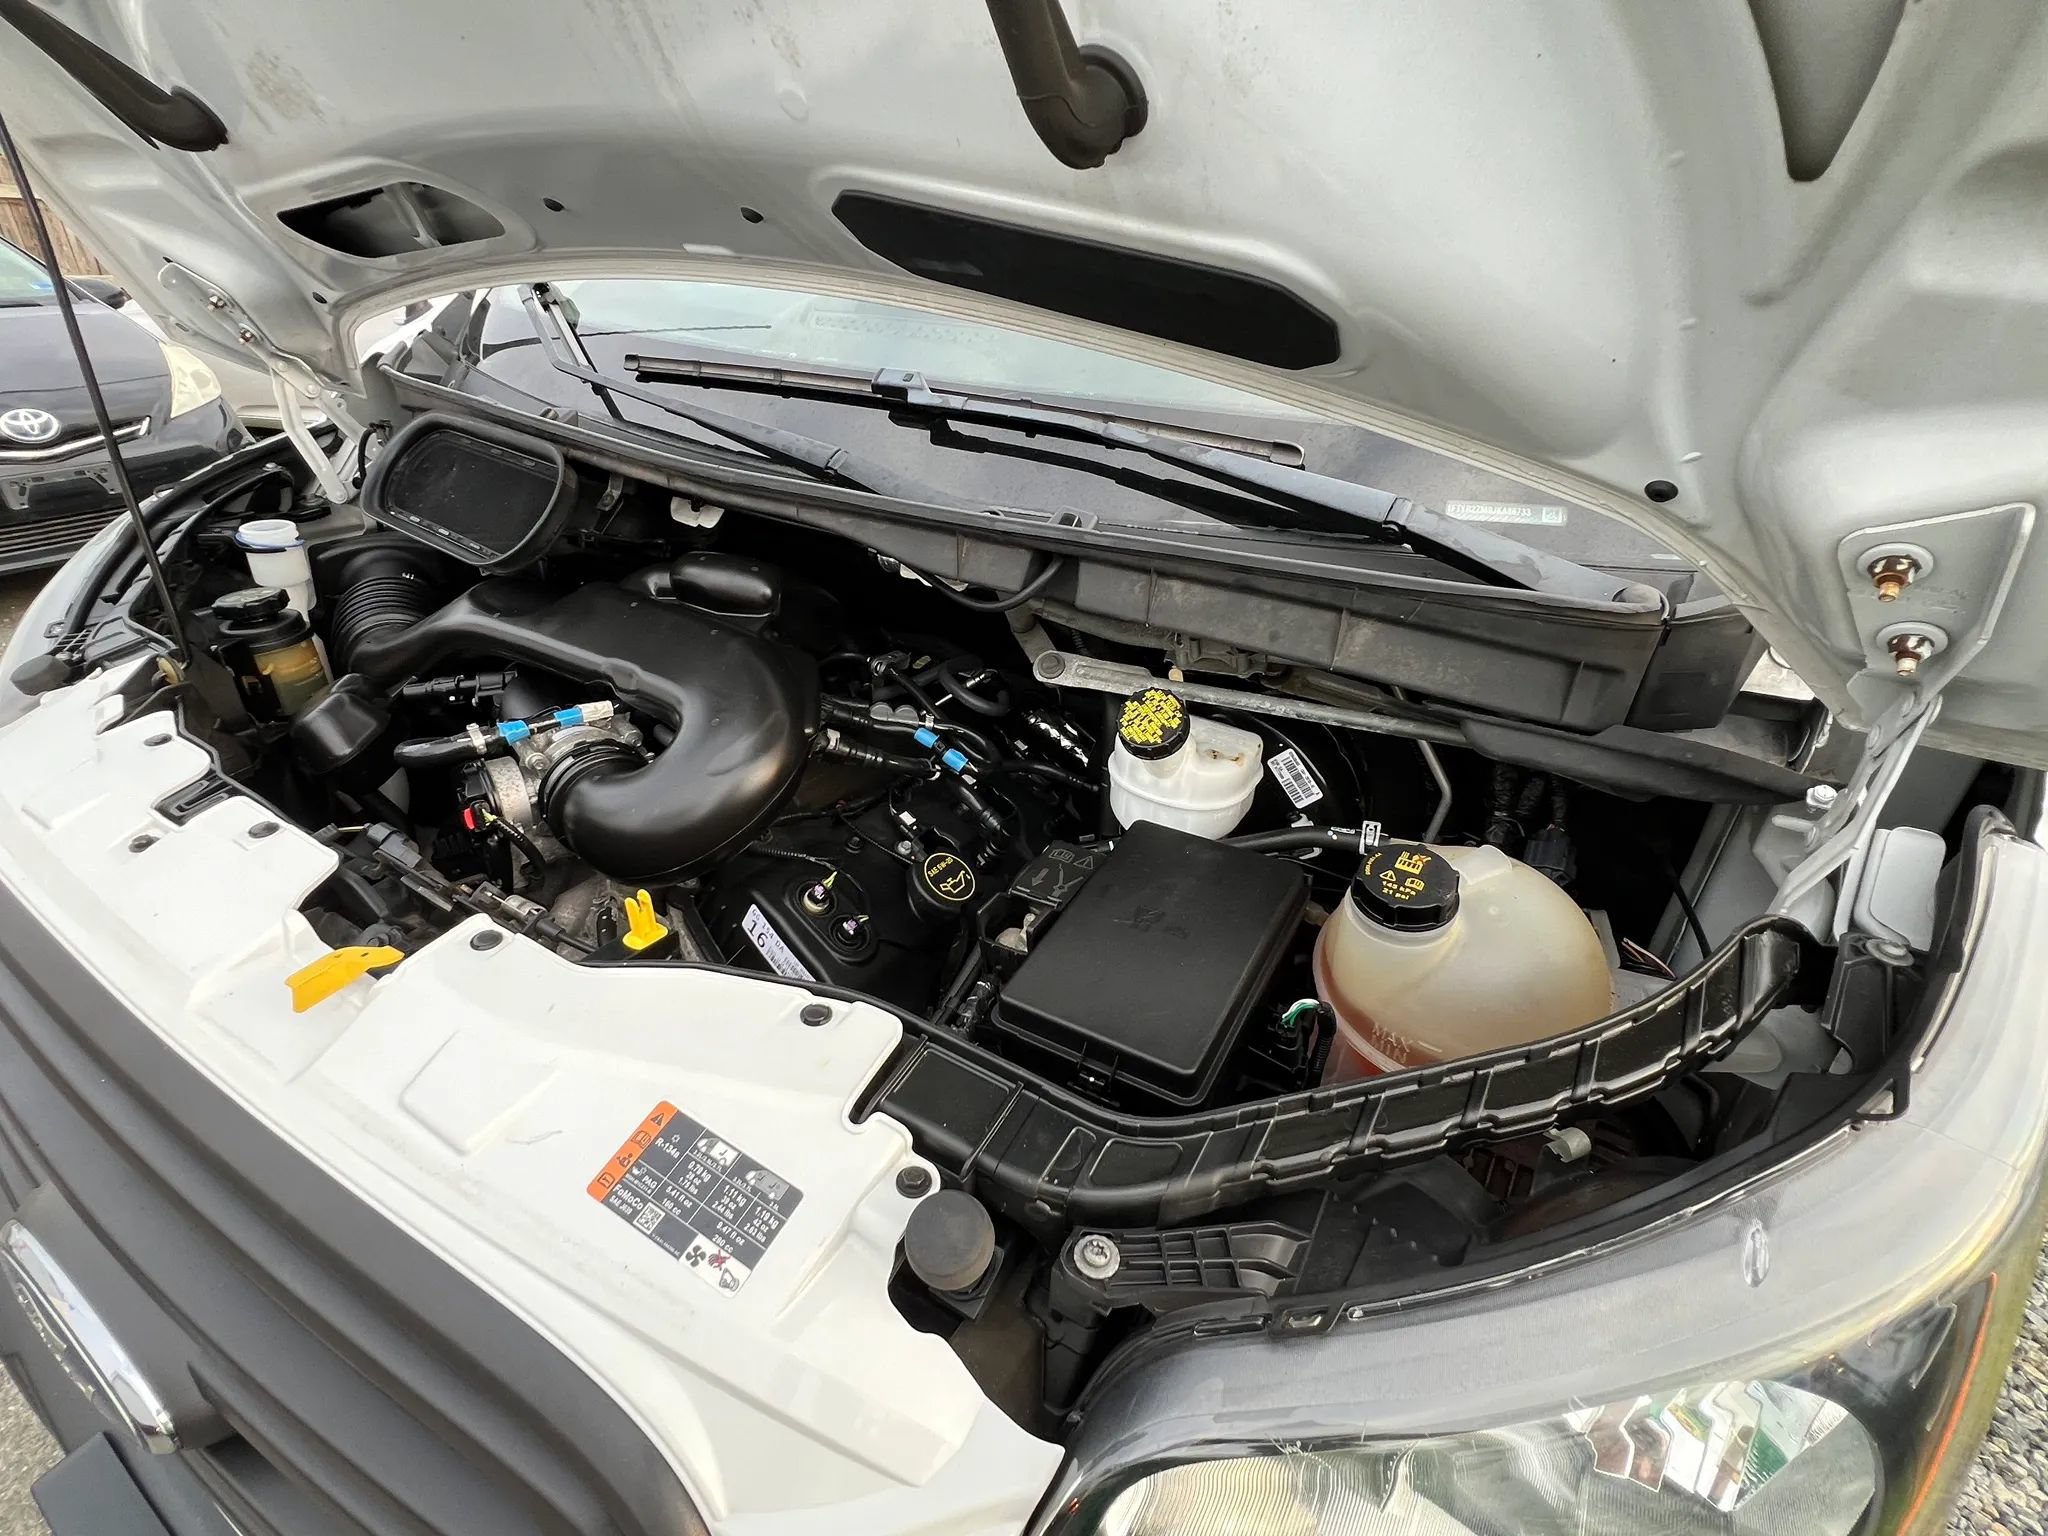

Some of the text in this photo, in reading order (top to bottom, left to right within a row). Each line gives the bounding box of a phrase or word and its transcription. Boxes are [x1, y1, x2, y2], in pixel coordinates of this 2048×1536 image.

[927, 857, 955, 878] SAE 5W-20
[1381, 879, 1415, 895] 145 kPa
[1382, 886, 1409, 901] 21 psi
[745, 918, 768, 950] 16
[641, 1175, 658, 1189] PAG
[691, 1177, 701, 1185] oz
[699, 1170, 712, 1182] kg
[687, 1184, 698, 1194] lbs
[723, 1184, 747, 1206] 1.11 kg
[609, 1195, 621, 1206] SAE
[612, 1184, 645, 1210] FoMoCo
[682, 1199, 692, 1207] oz
[671, 1206, 681, 1215] cc
[711, 1201, 734, 1219] 2.44 lbs
[727, 1201, 736, 1209] oz
[752, 1217, 769, 1232] 42 oz
[767, 1216, 780, 1229] kg
[743, 1223, 767, 1242] 2.63 lbs
[735, 1236, 745, 1245] oz
[724, 1243, 733, 1252] cc
